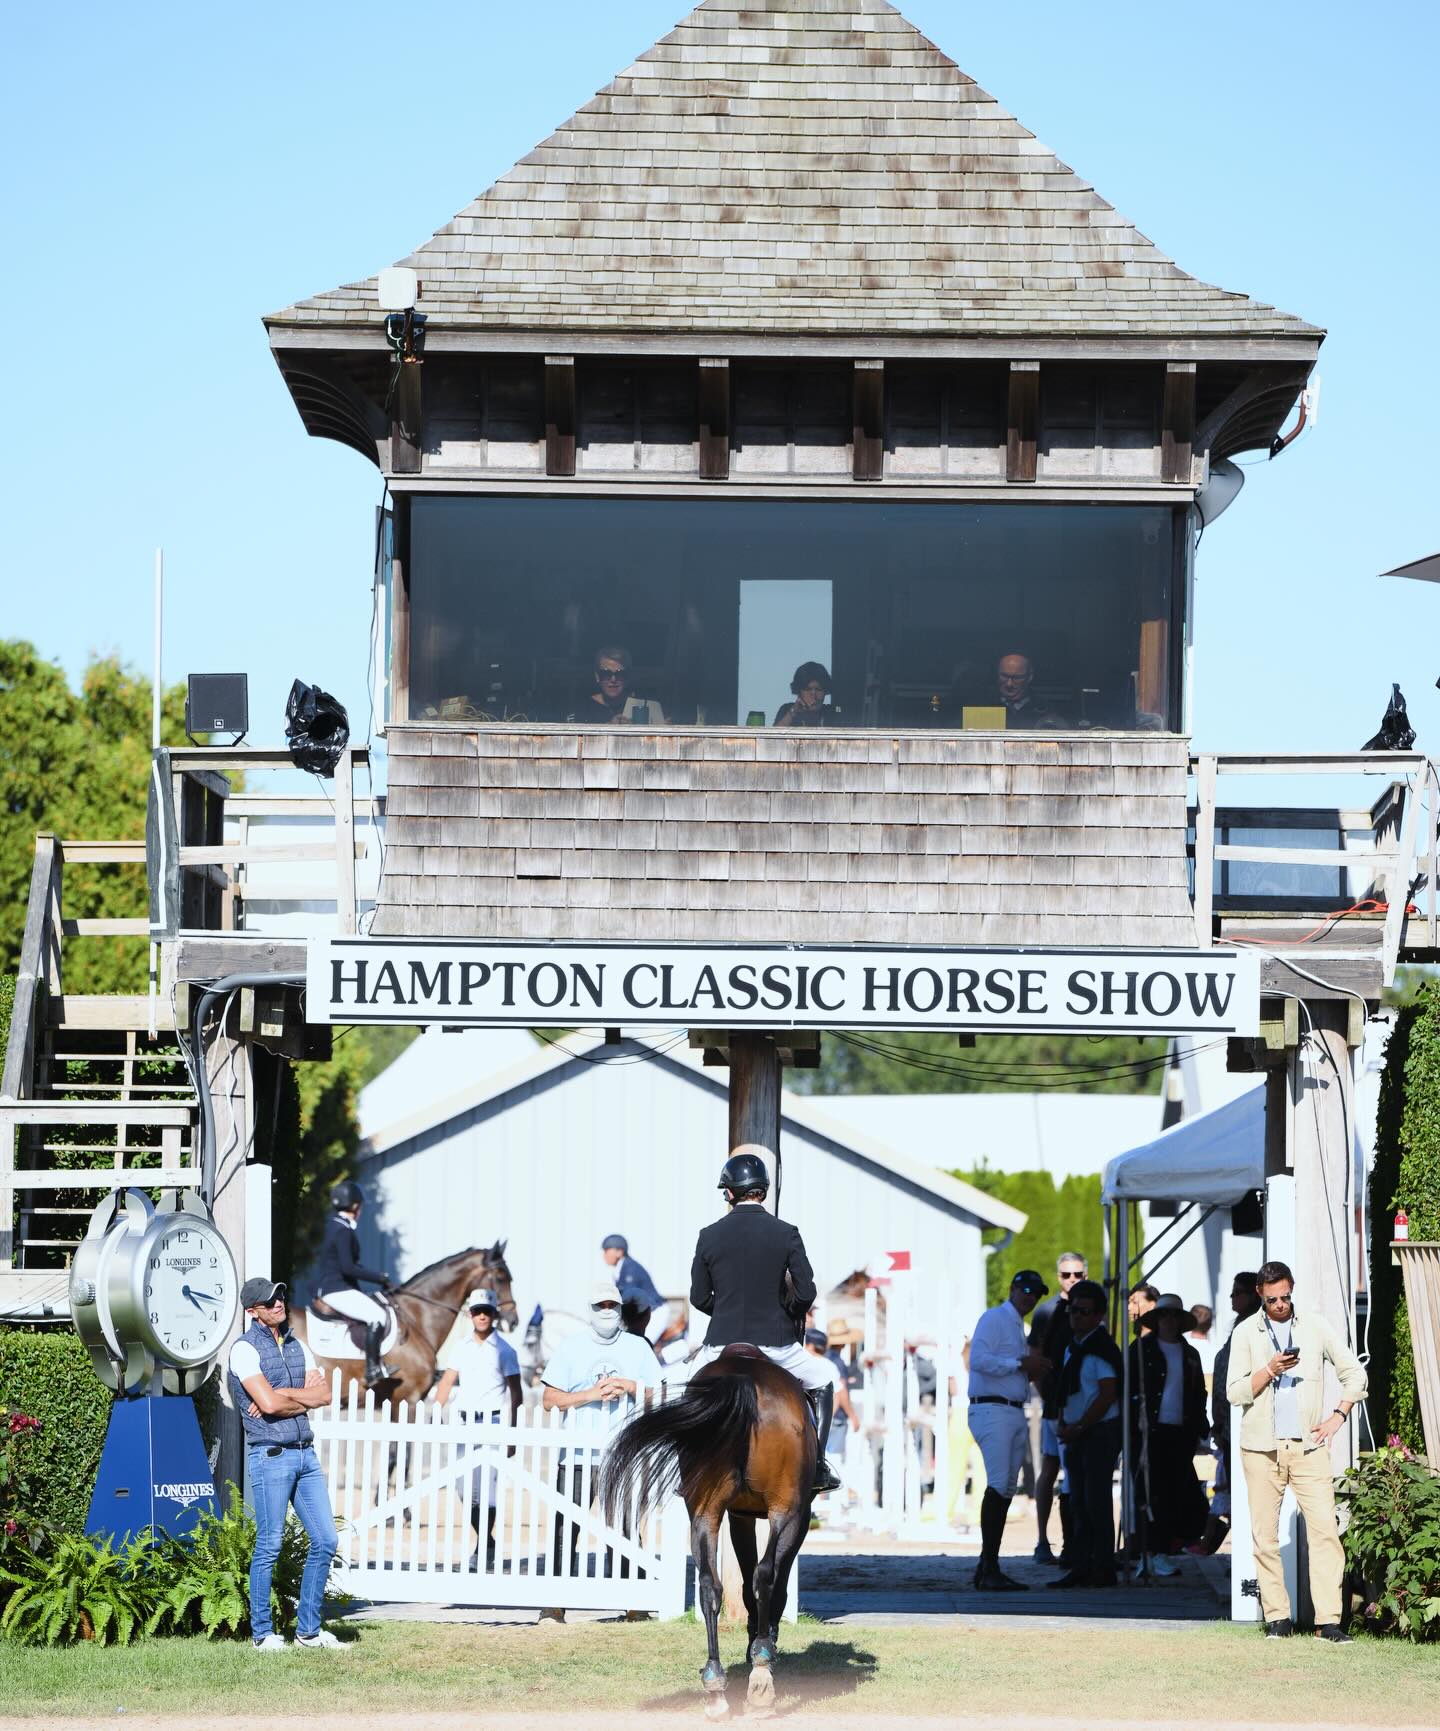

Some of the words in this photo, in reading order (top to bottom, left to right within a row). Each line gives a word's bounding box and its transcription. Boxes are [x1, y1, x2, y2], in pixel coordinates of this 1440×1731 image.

[329, 958, 608, 1013] HAMPTON
[622, 962, 847, 1012] CLASSIC
[861, 966, 1049, 1014] HORSE
[1065, 969, 1237, 1018] SHOW
[177, 1231, 189, 1243] 12
[150, 1257, 160, 1270] 10
[165, 1257, 201, 1266] LONGINES
[209, 1257, 217, 1268] 2
[145, 1285, 153, 1297] 9
[214, 1283, 223, 1296] 3
[150, 1312, 159, 1324] 8
[209, 1310, 218, 1322] 4
[163, 1332, 171, 1344] 7
[199, 1331, 206, 1342] 5
[181, 1338, 189, 1350] 6
[153, 1483, 215, 1497] LONGINES
